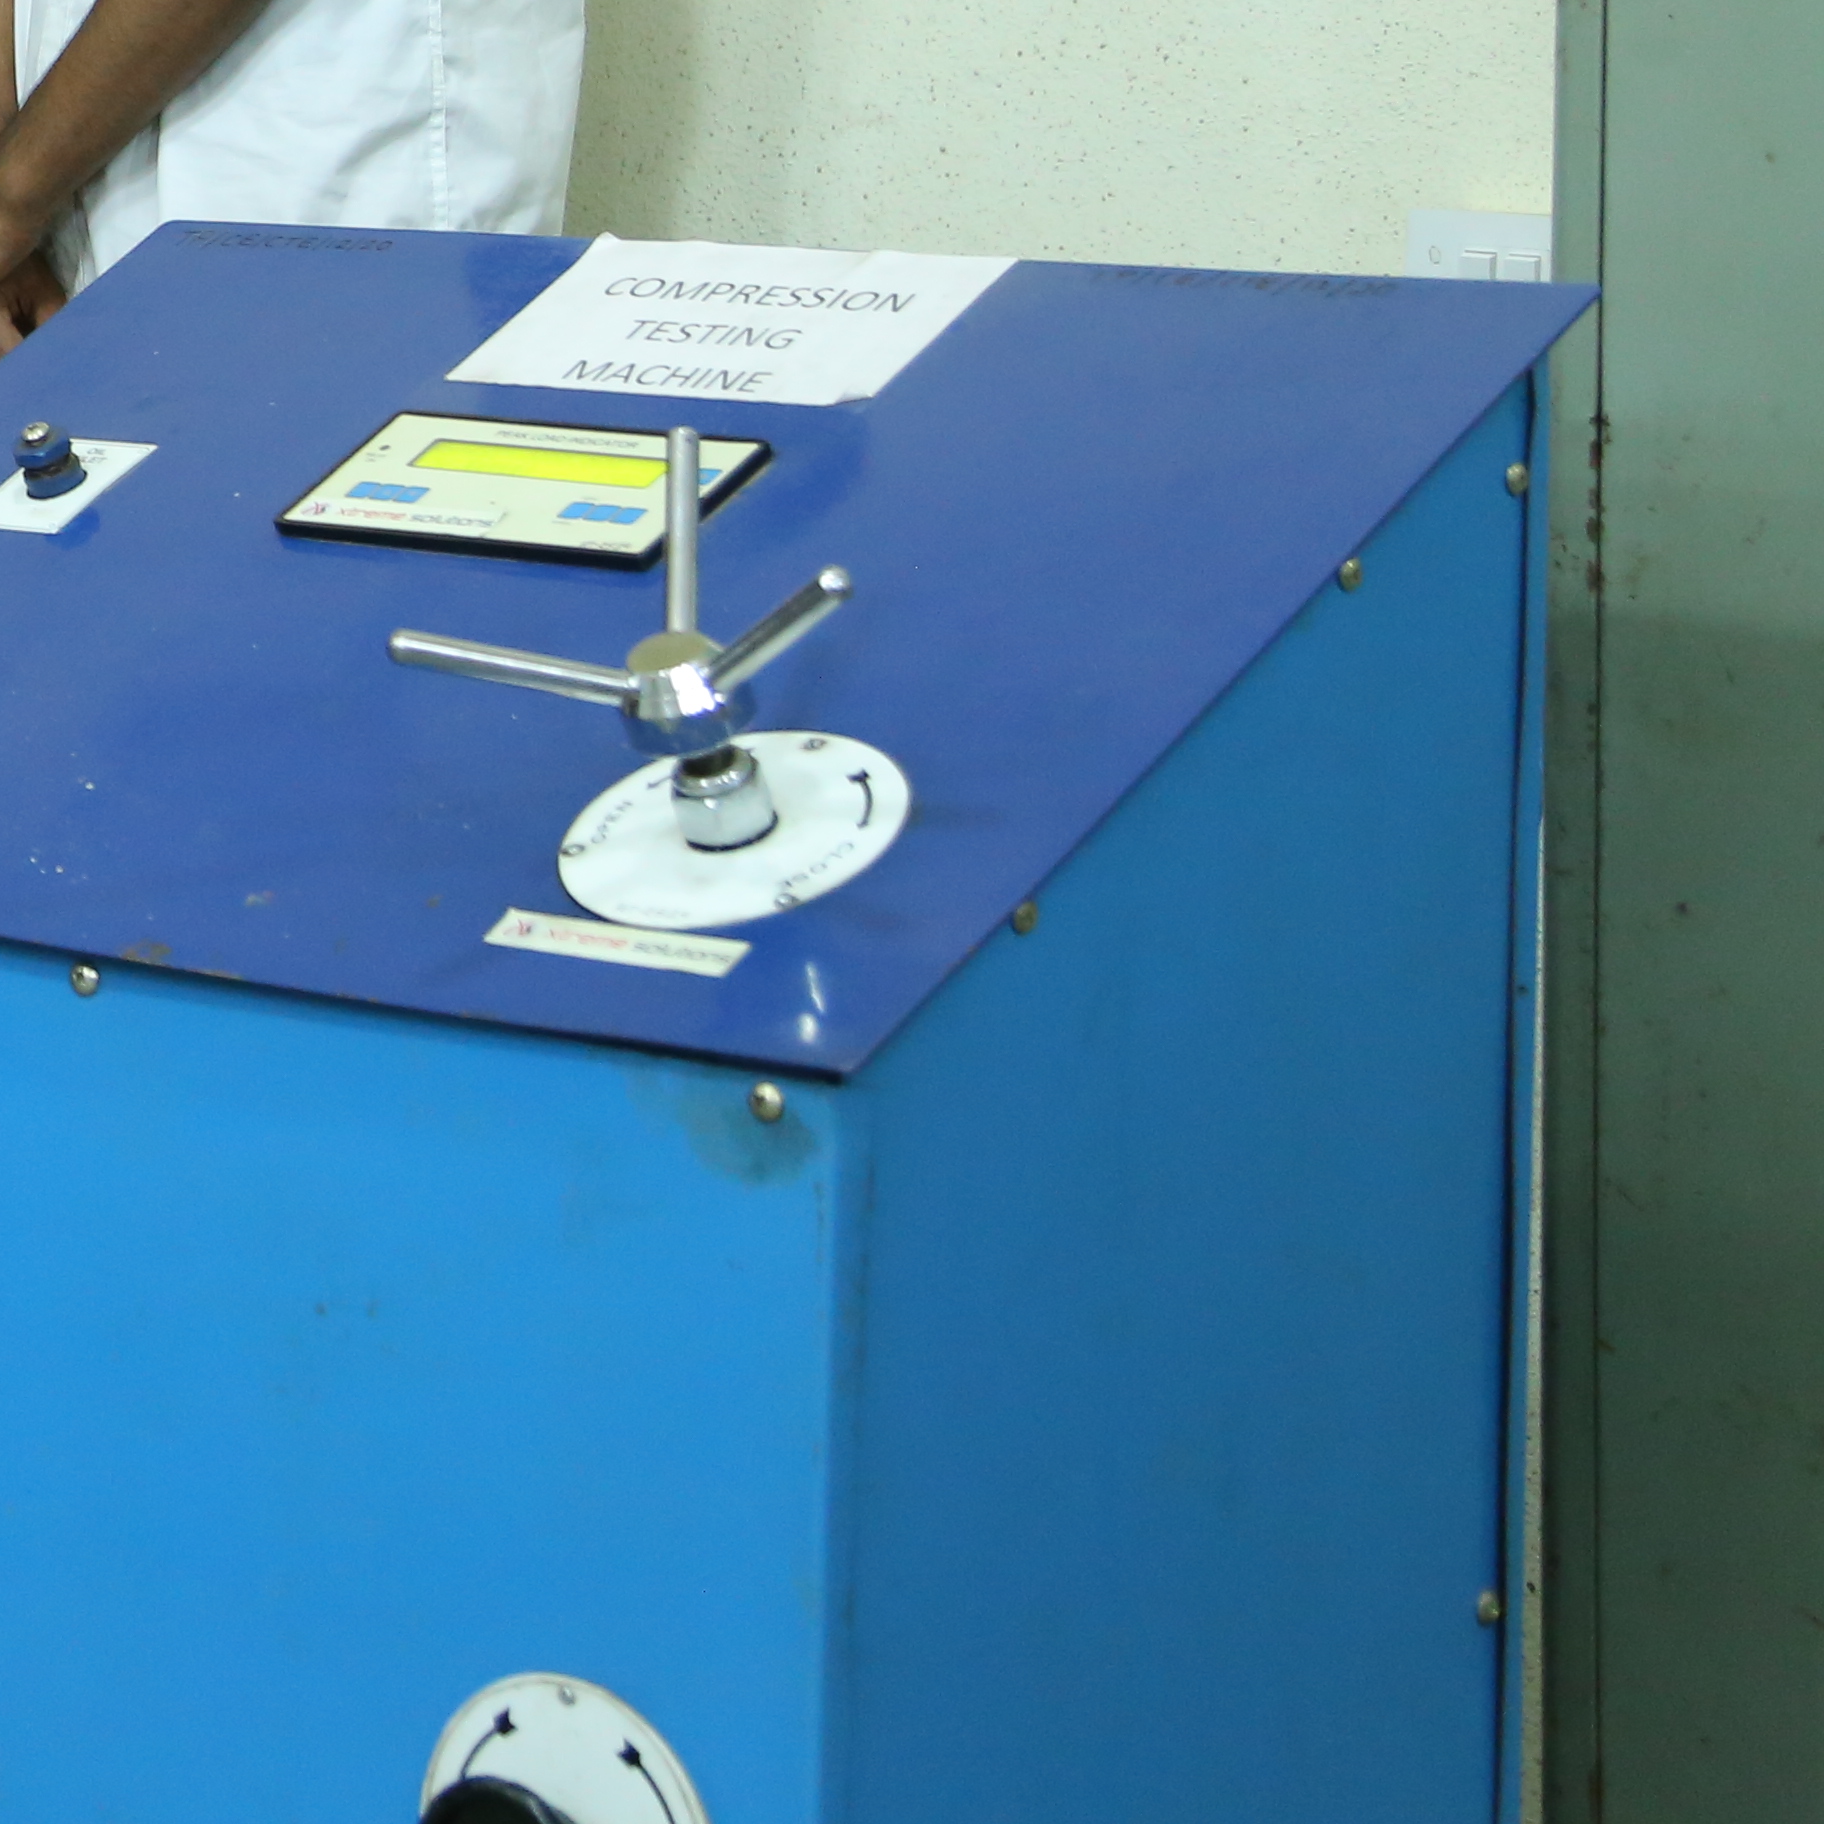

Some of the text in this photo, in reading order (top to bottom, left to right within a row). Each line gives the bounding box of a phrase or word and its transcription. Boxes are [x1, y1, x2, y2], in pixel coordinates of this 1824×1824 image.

[602, 276, 916, 314] COMPRESSION
[624, 319, 804, 350] TESTING
[561, 358, 774, 394] MACHINE
